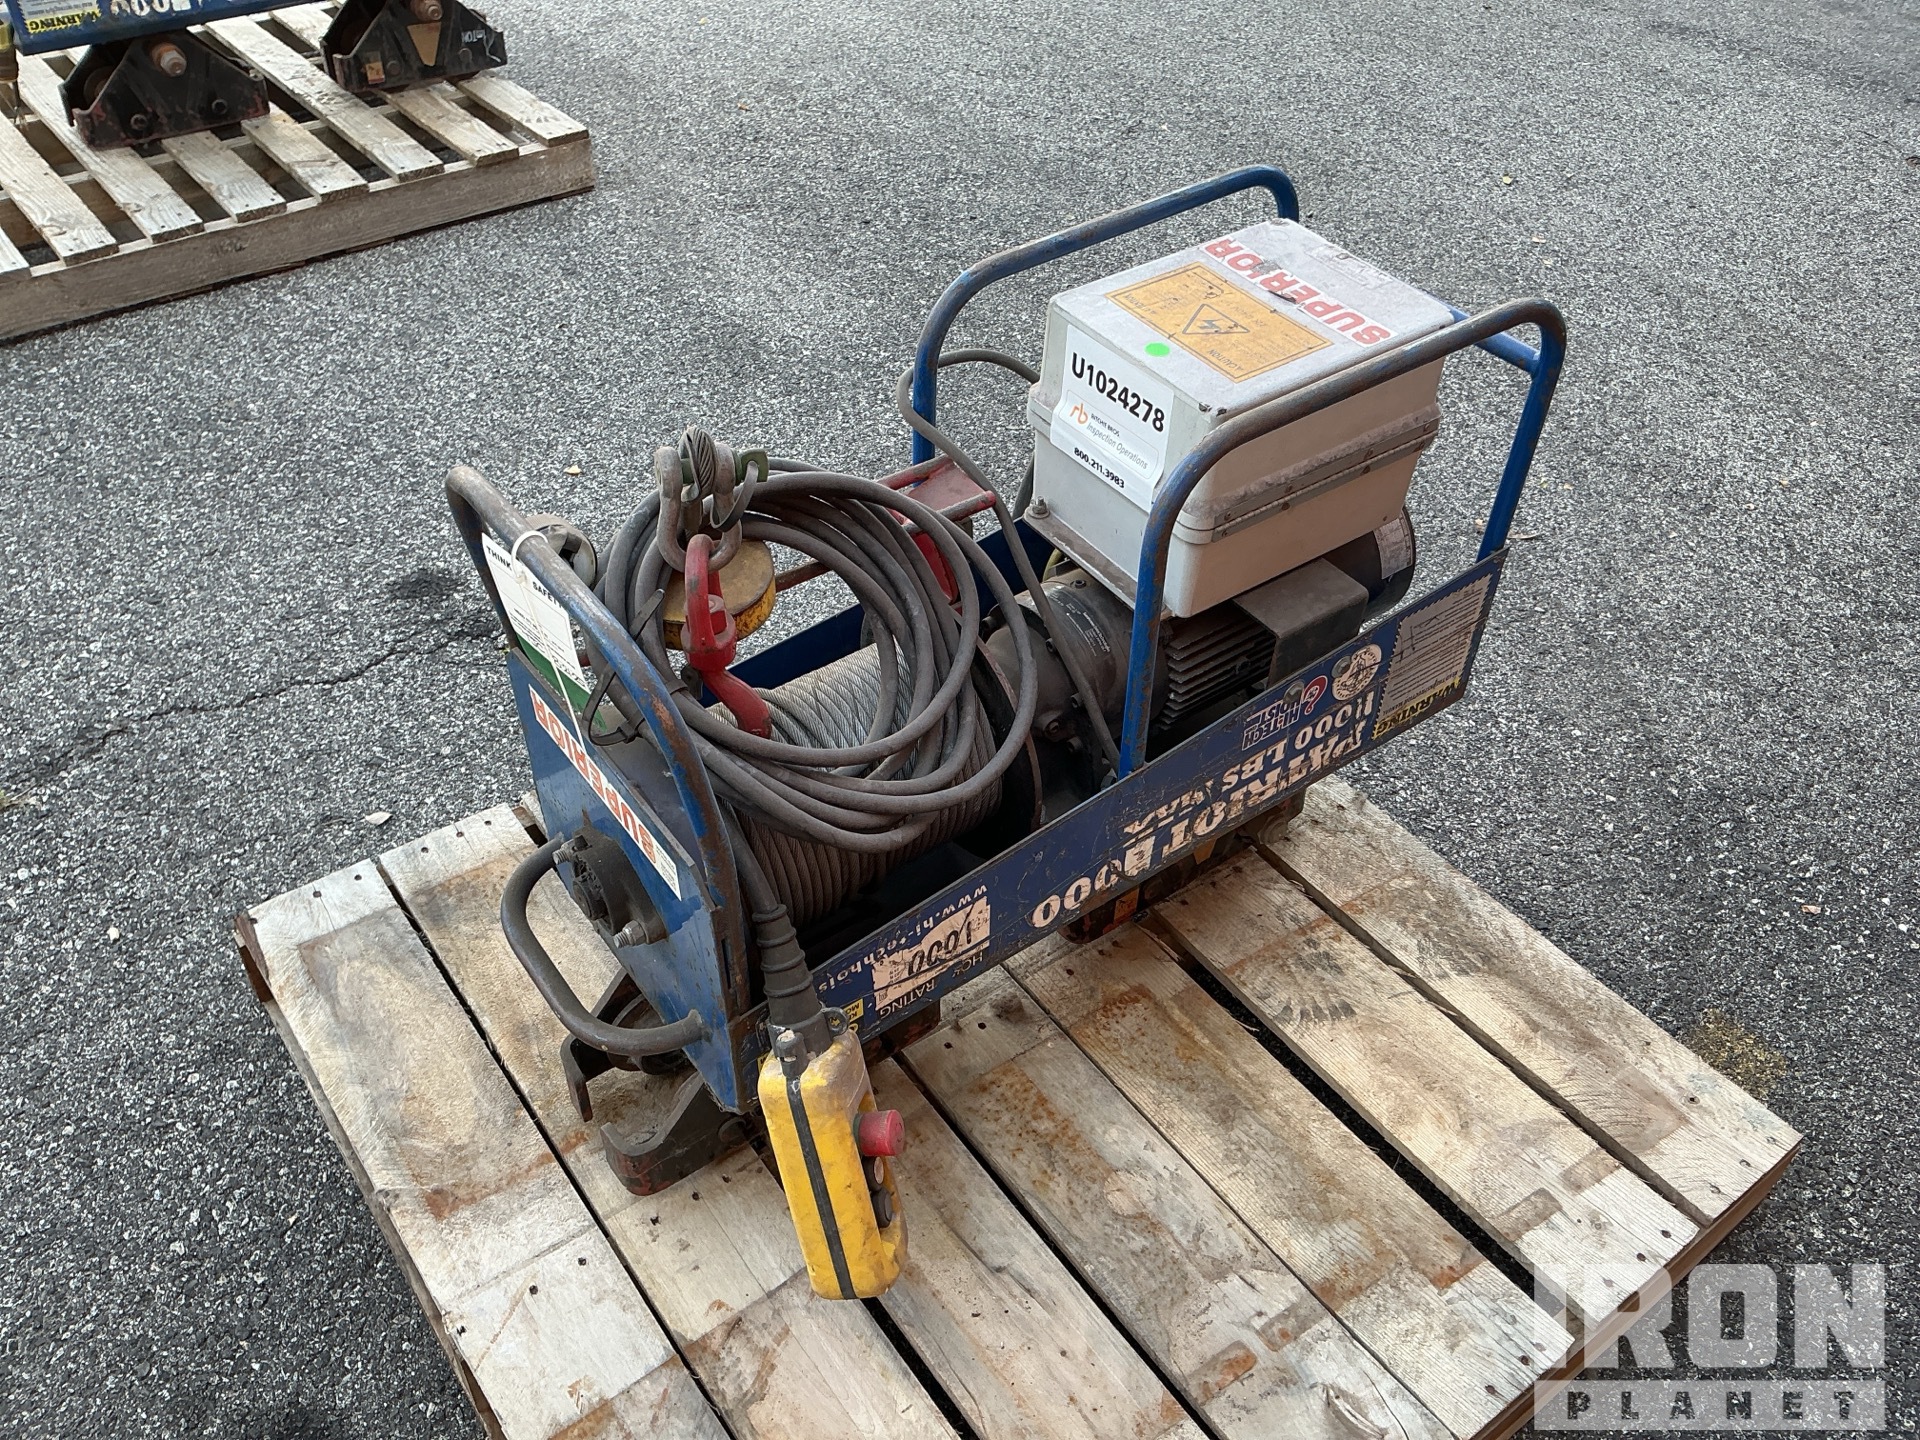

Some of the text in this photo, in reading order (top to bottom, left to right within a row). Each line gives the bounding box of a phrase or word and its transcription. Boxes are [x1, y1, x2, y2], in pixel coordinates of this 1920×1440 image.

[29, 11, 99, 31] WARNING
[1205, 238, 1391, 345] SUPERIOR
[1072, 352, 1165, 433] U1024278
[1086, 422, 1148, 470] Inspection Operations
[1091, 413, 1108, 427] RITCHIE
[1074, 447, 1125, 489] 800.211.3983
[486, 546, 562, 609] THINK SAFET
[1376, 681, 1457, 734] WARNING
[531, 690, 656, 864] SUPERIOR
[1162, 719, 1367, 858] PATRIOT
[1222, 739, 1288, 792] LBS
[907, 921, 973, 977] 1000
[879, 978, 937, 1018] RATING
